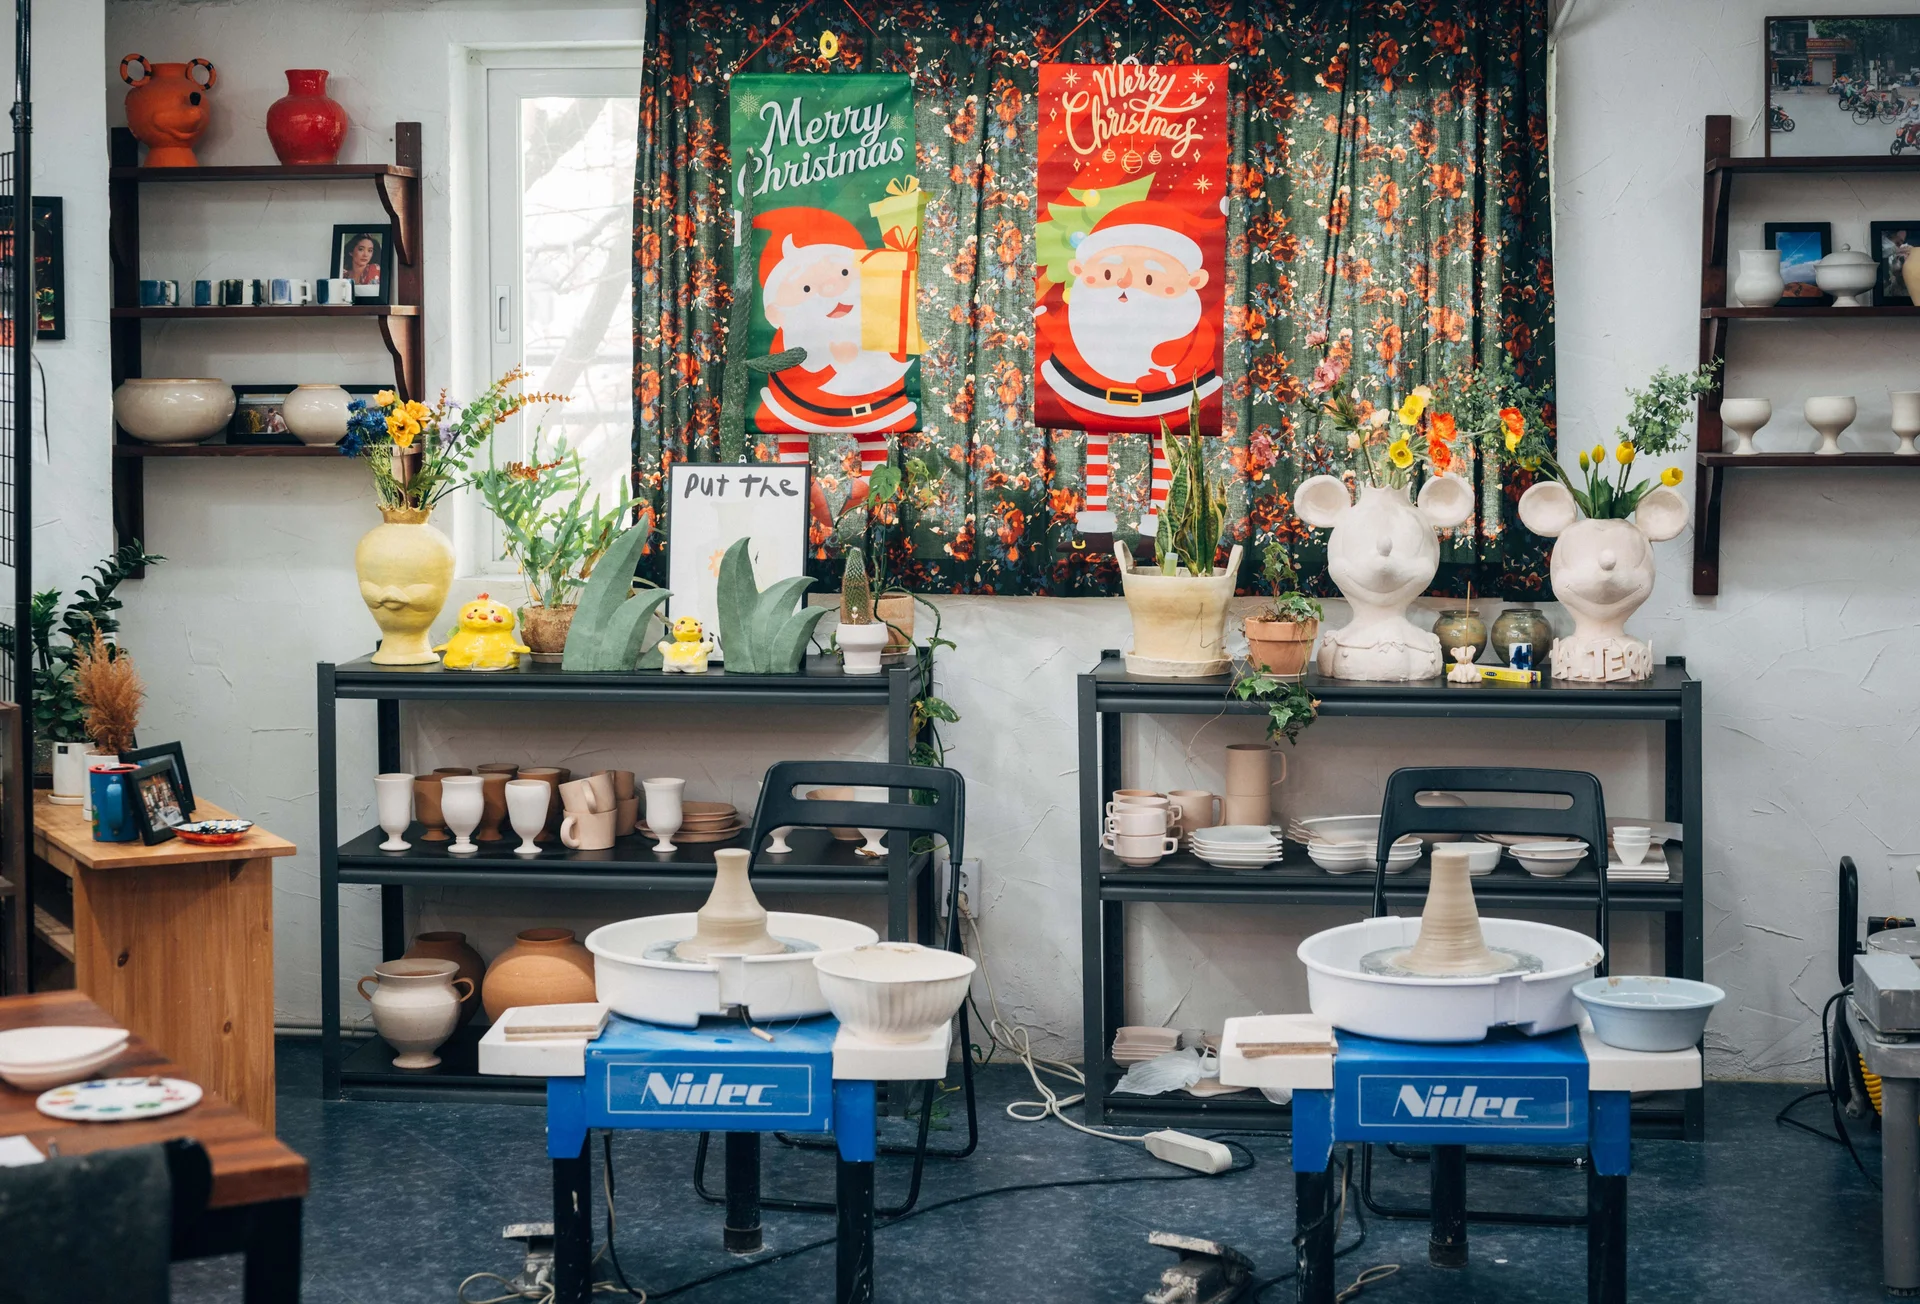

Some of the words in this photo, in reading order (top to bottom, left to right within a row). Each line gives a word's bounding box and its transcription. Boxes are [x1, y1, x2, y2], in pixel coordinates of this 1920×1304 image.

[1093, 64, 1177, 106] Merry
[759, 96, 890, 153] Merry
[1062, 91, 1206, 158] Christmas
[737, 137, 906, 197] Christmas
[641, 1072, 778, 1106] Nidec
[1393, 1084, 1534, 1118] Nidec
